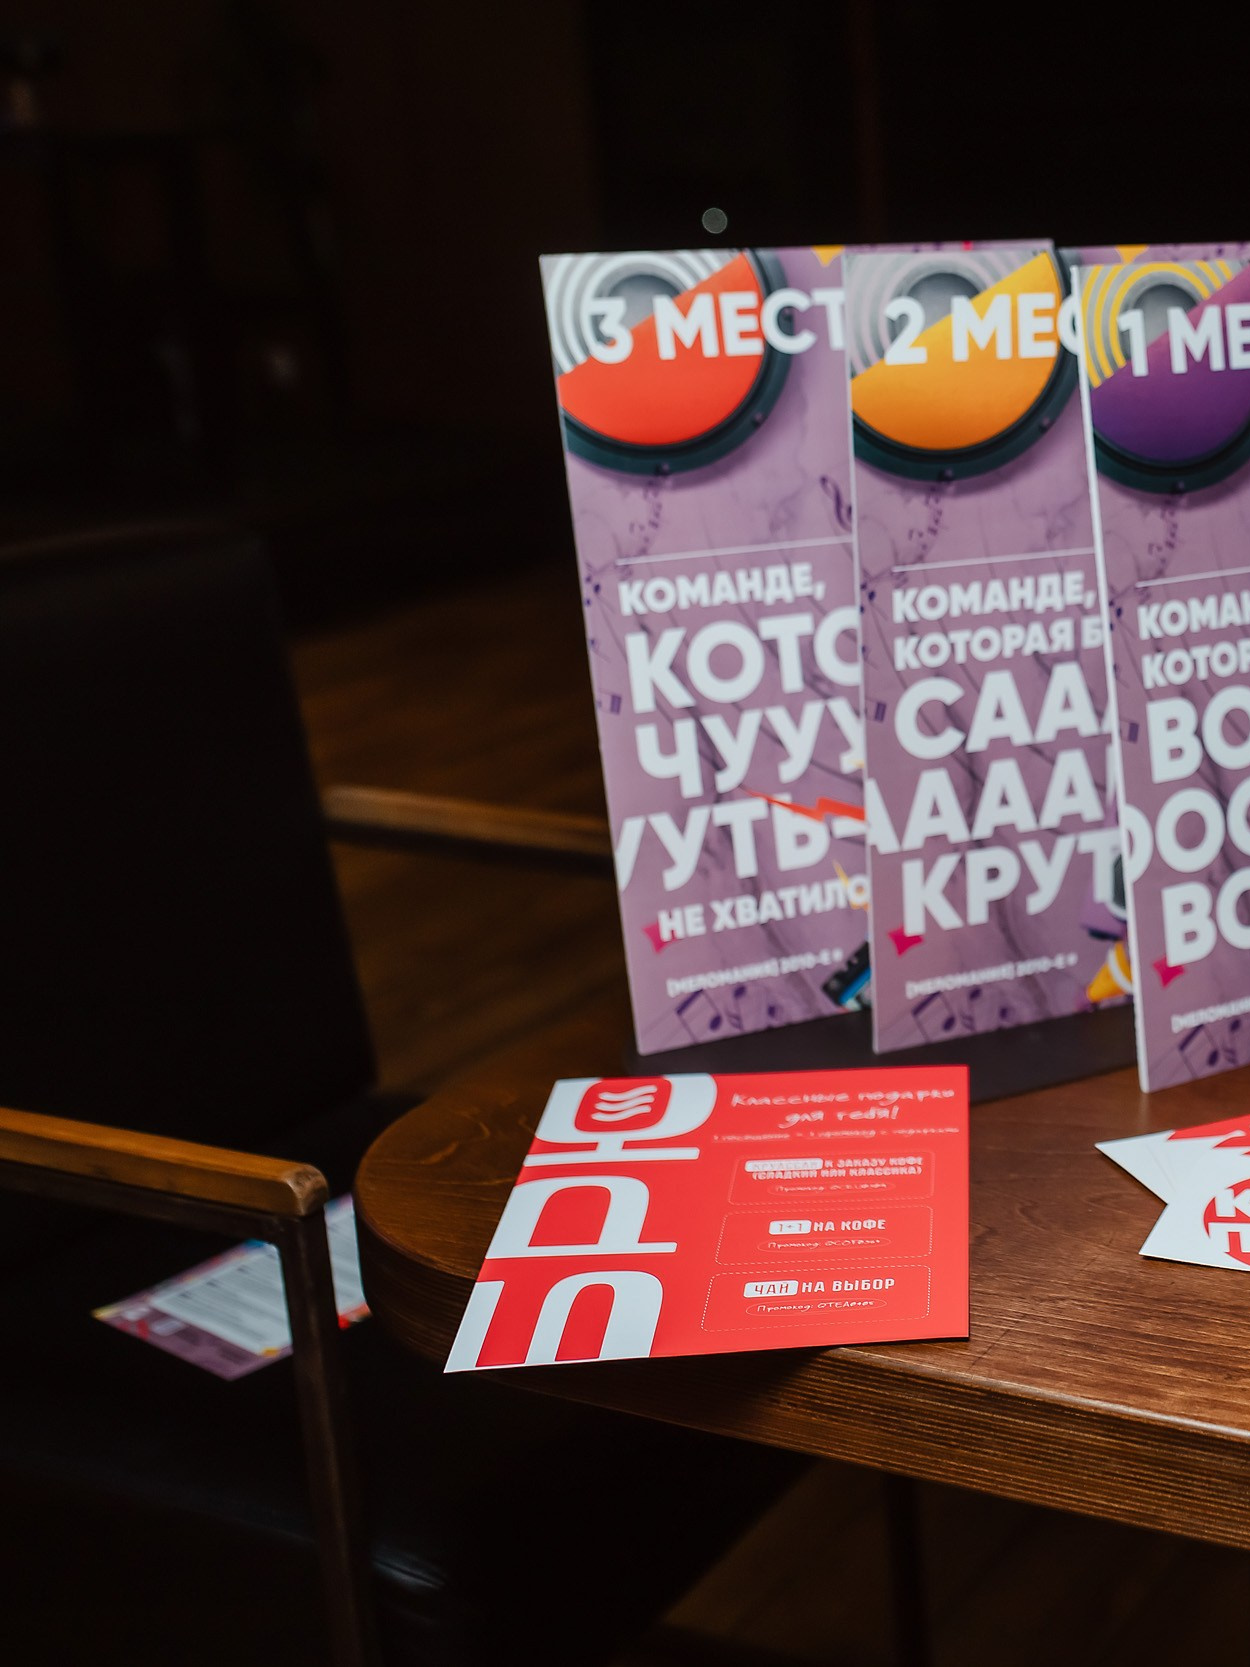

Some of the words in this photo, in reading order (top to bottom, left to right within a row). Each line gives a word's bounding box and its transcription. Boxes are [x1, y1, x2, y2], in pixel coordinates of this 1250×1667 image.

[587, 296, 632, 364] 3
[884, 295, 928, 365] 2
[1117, 308, 1149, 377] 1
[618, 563, 824, 616] КОМАНДЕ,
[892, 571, 1096, 623] КОМАНДЕ,
[894, 617, 1074, 671] КОТОРАЯ
[657, 904, 706, 941] НЕ
[710, 874, 870, 933] ХВАТИЛО
[813, 1221, 836, 1232] НА
[840, 1219, 887, 1231] КОФЕ
[801, 1281, 825, 1293] НА
[832, 1278, 895, 1292] ВЫБОР
